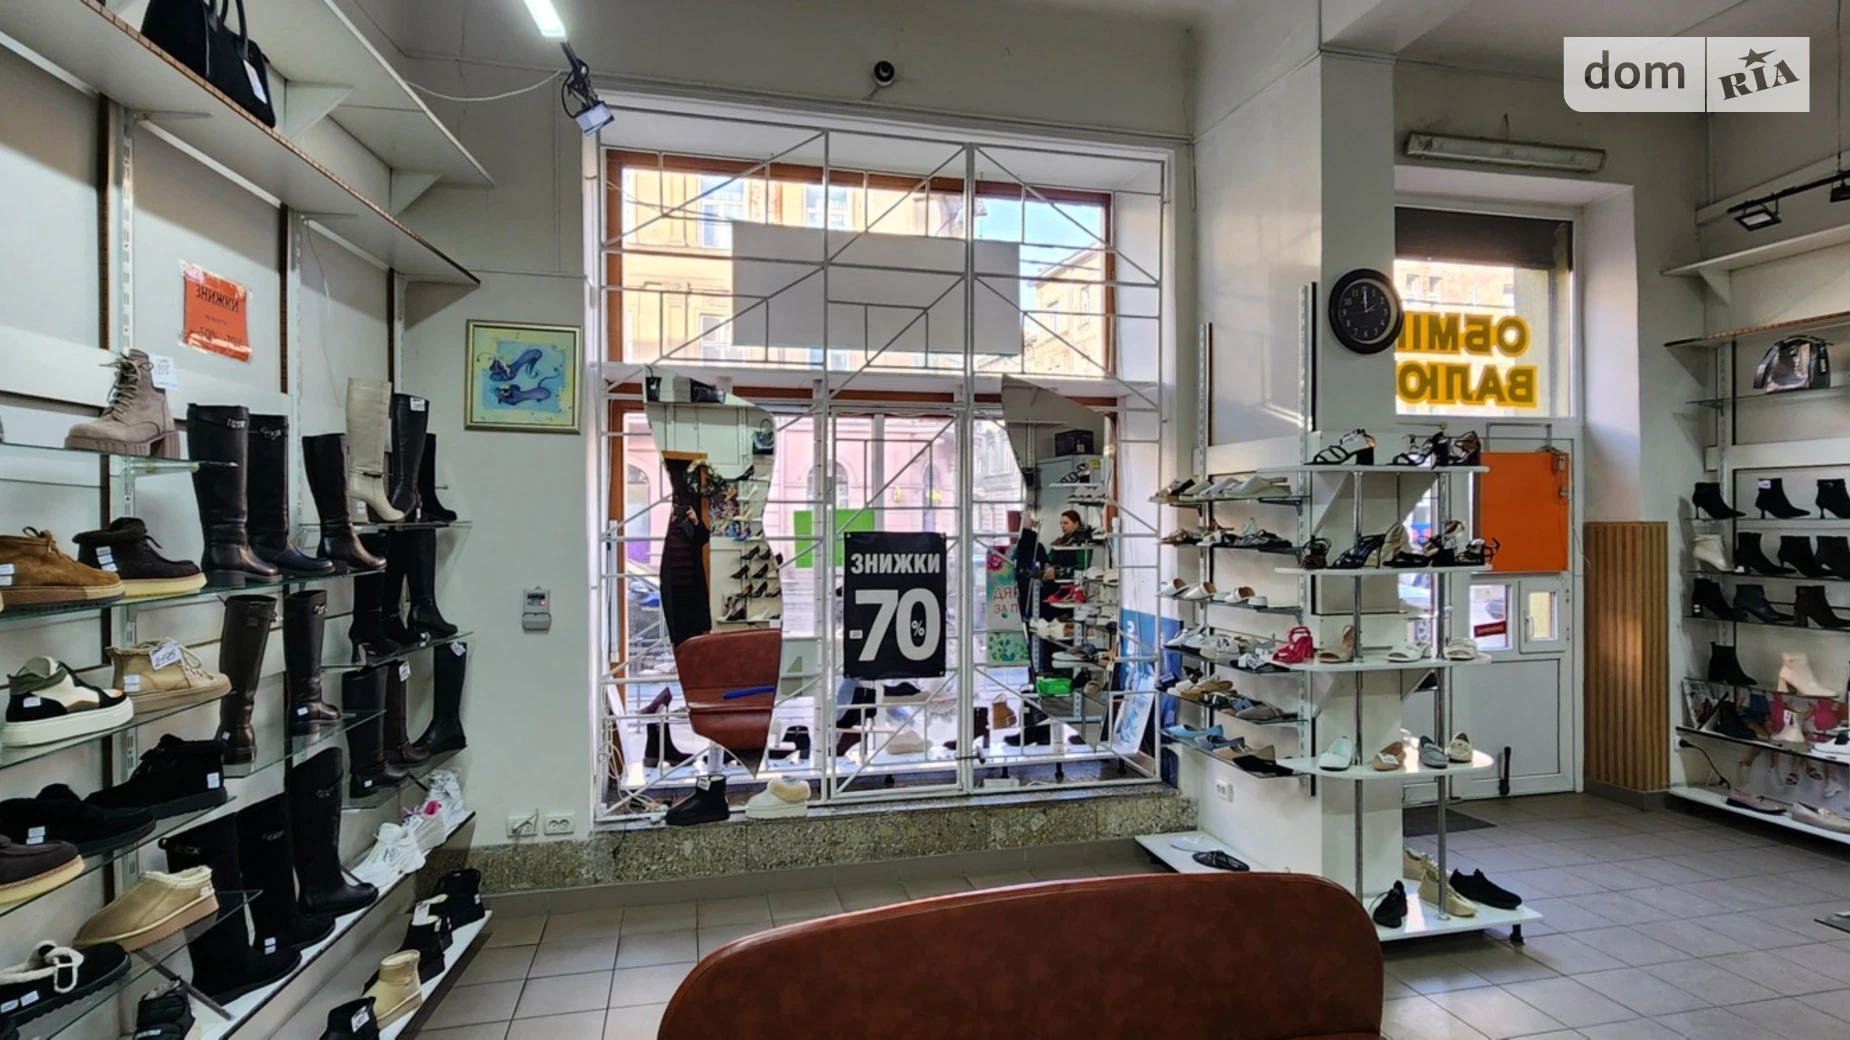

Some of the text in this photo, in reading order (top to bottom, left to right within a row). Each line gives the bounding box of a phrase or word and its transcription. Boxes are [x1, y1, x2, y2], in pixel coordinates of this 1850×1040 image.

[195, 283, 240, 314] ЗНИЖКИ
[850, 552, 941, 575] ЗНИЖКИ
[993, 603, 1008, 614] ЗА
